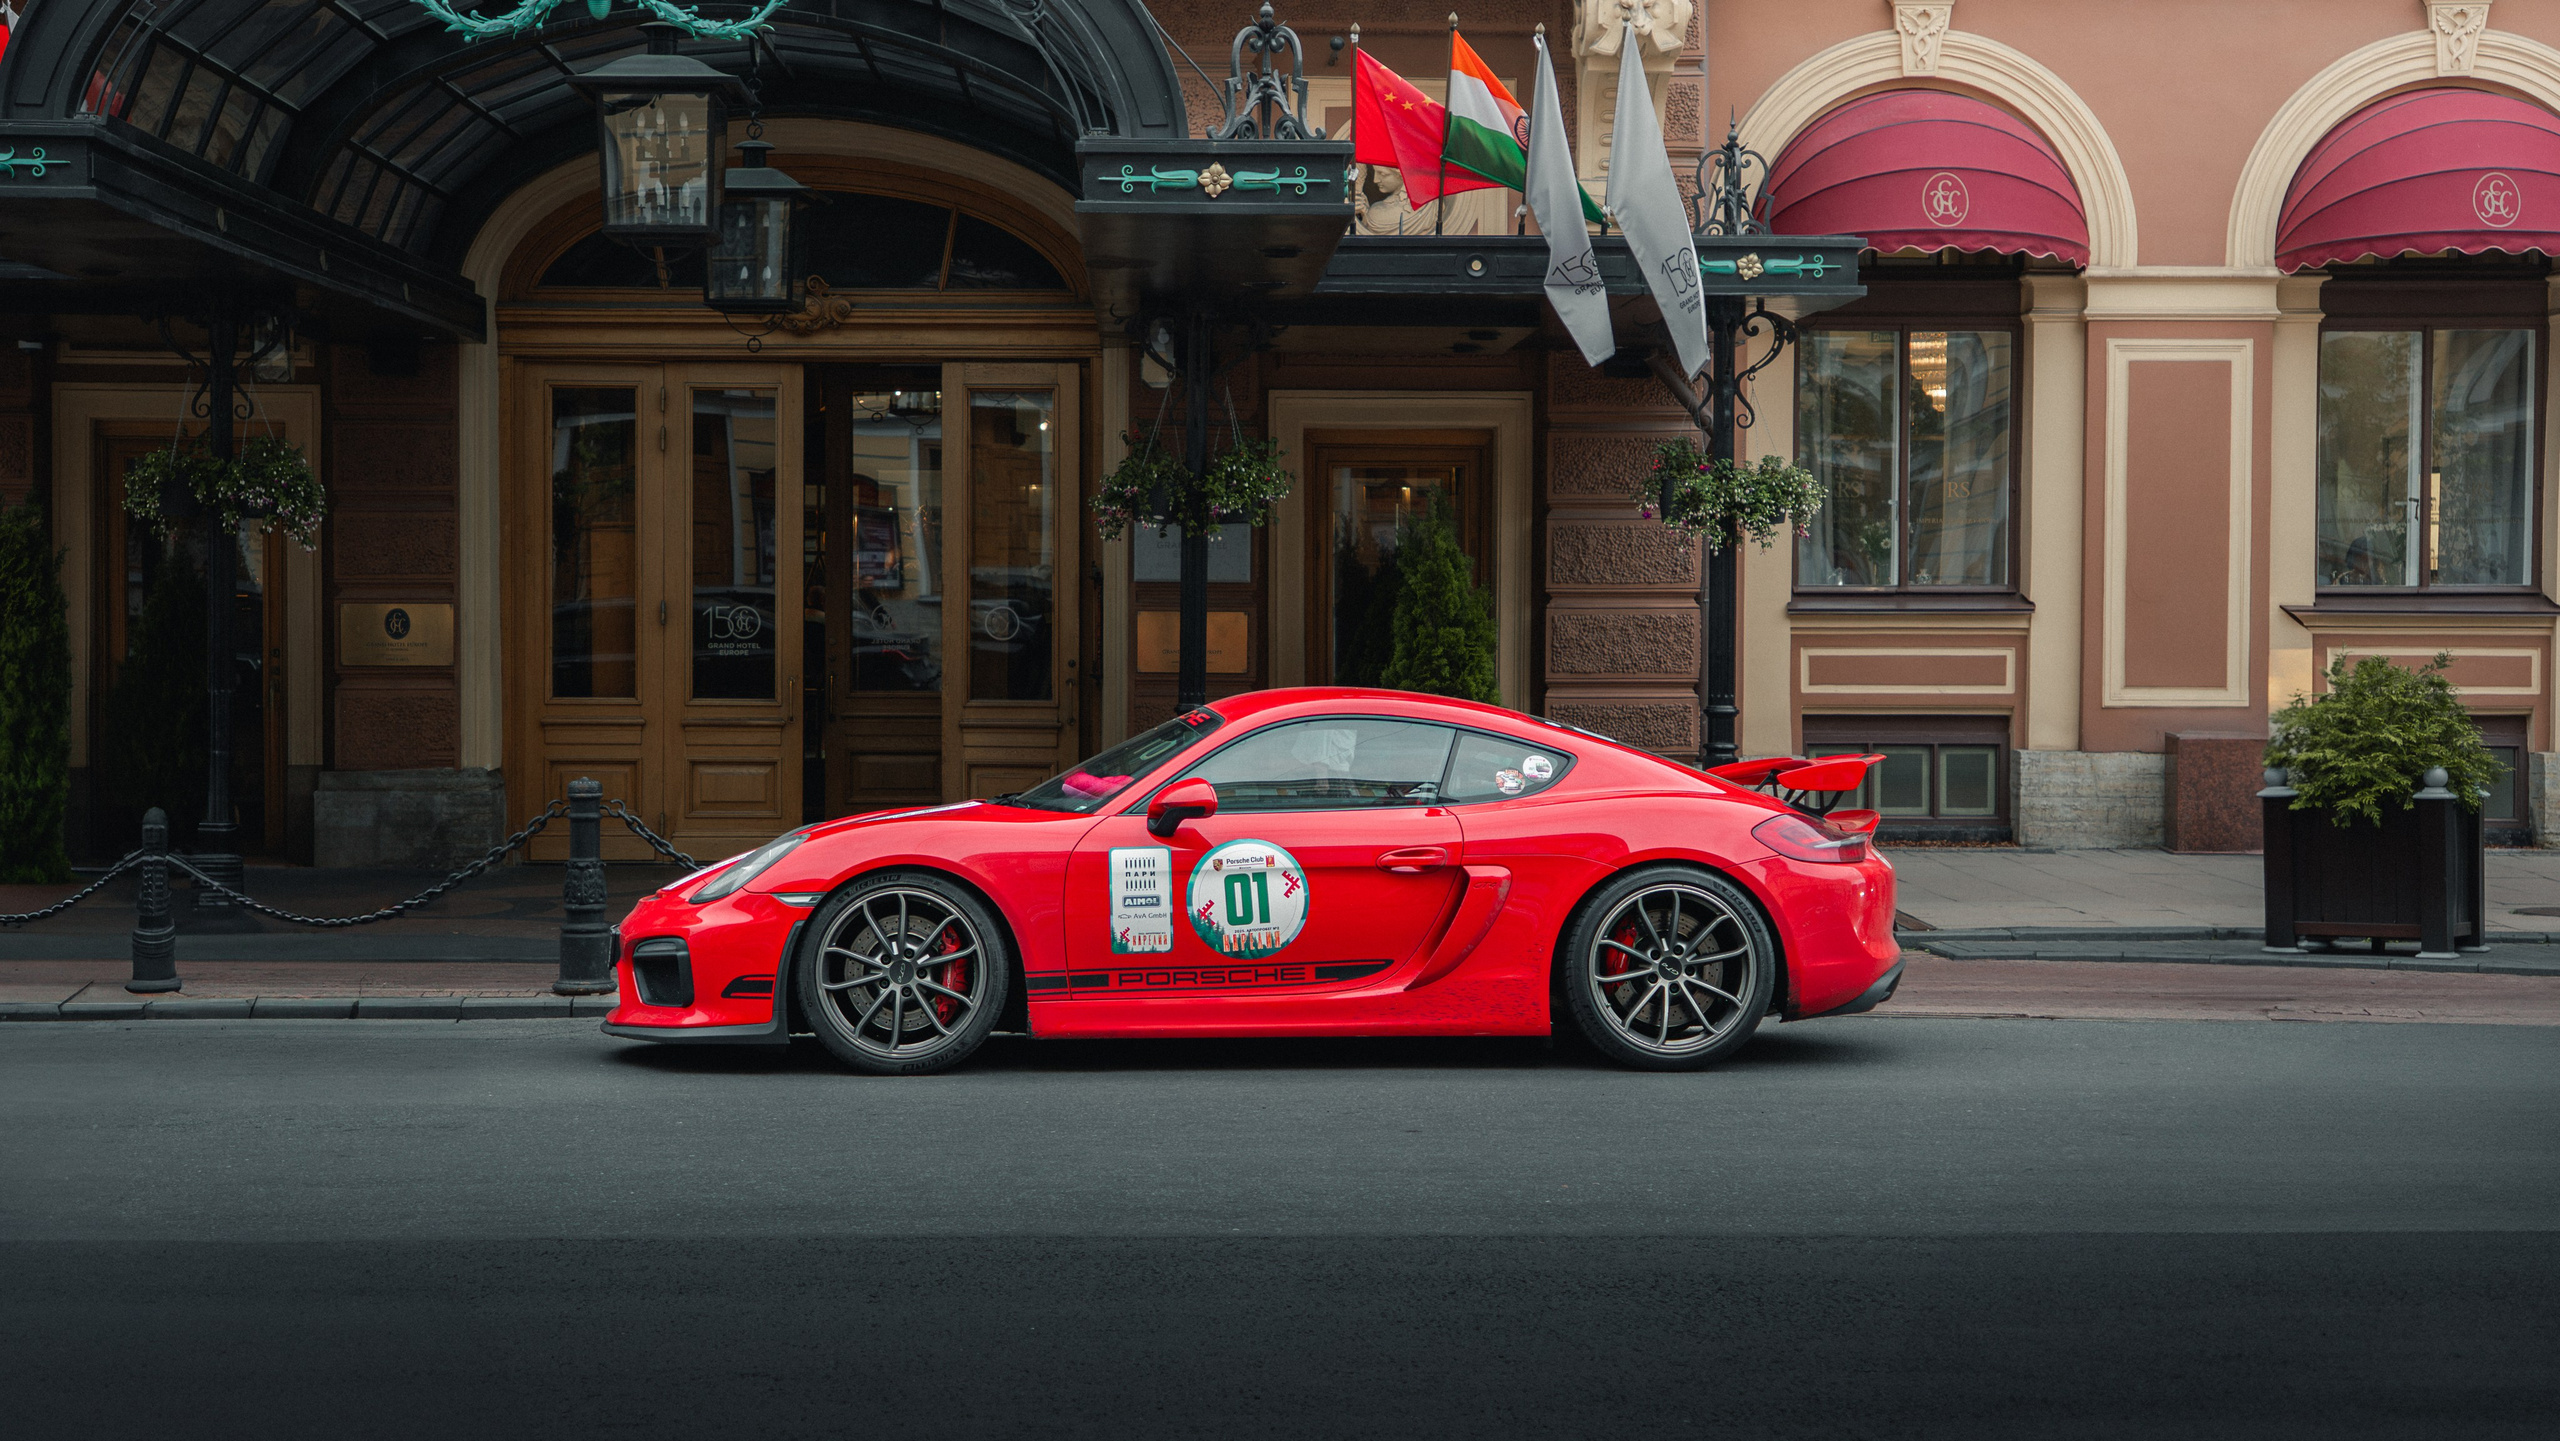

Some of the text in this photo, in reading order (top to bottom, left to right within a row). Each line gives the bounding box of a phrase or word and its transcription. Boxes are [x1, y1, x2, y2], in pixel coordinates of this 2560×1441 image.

[1661, 247, 1698, 298] 150
[1679, 295, 1694, 310] GRAND
[1948, 481, 1970, 498] RS
[702, 605, 761, 639] 150
[1226, 857, 1250, 865] Porsche
[848, 874, 901, 895] MICHELIN
[1124, 897, 1159, 906] AIMOL
[1224, 871, 1271, 926] 01
[1723, 888, 1762, 933] MICHELIN
[1132, 934, 1168, 946] КАРЕЛИЯ
[1222, 931, 1281, 952] КАРЕЛИЯ
[1118, 967, 1306, 986] PORSCHE
